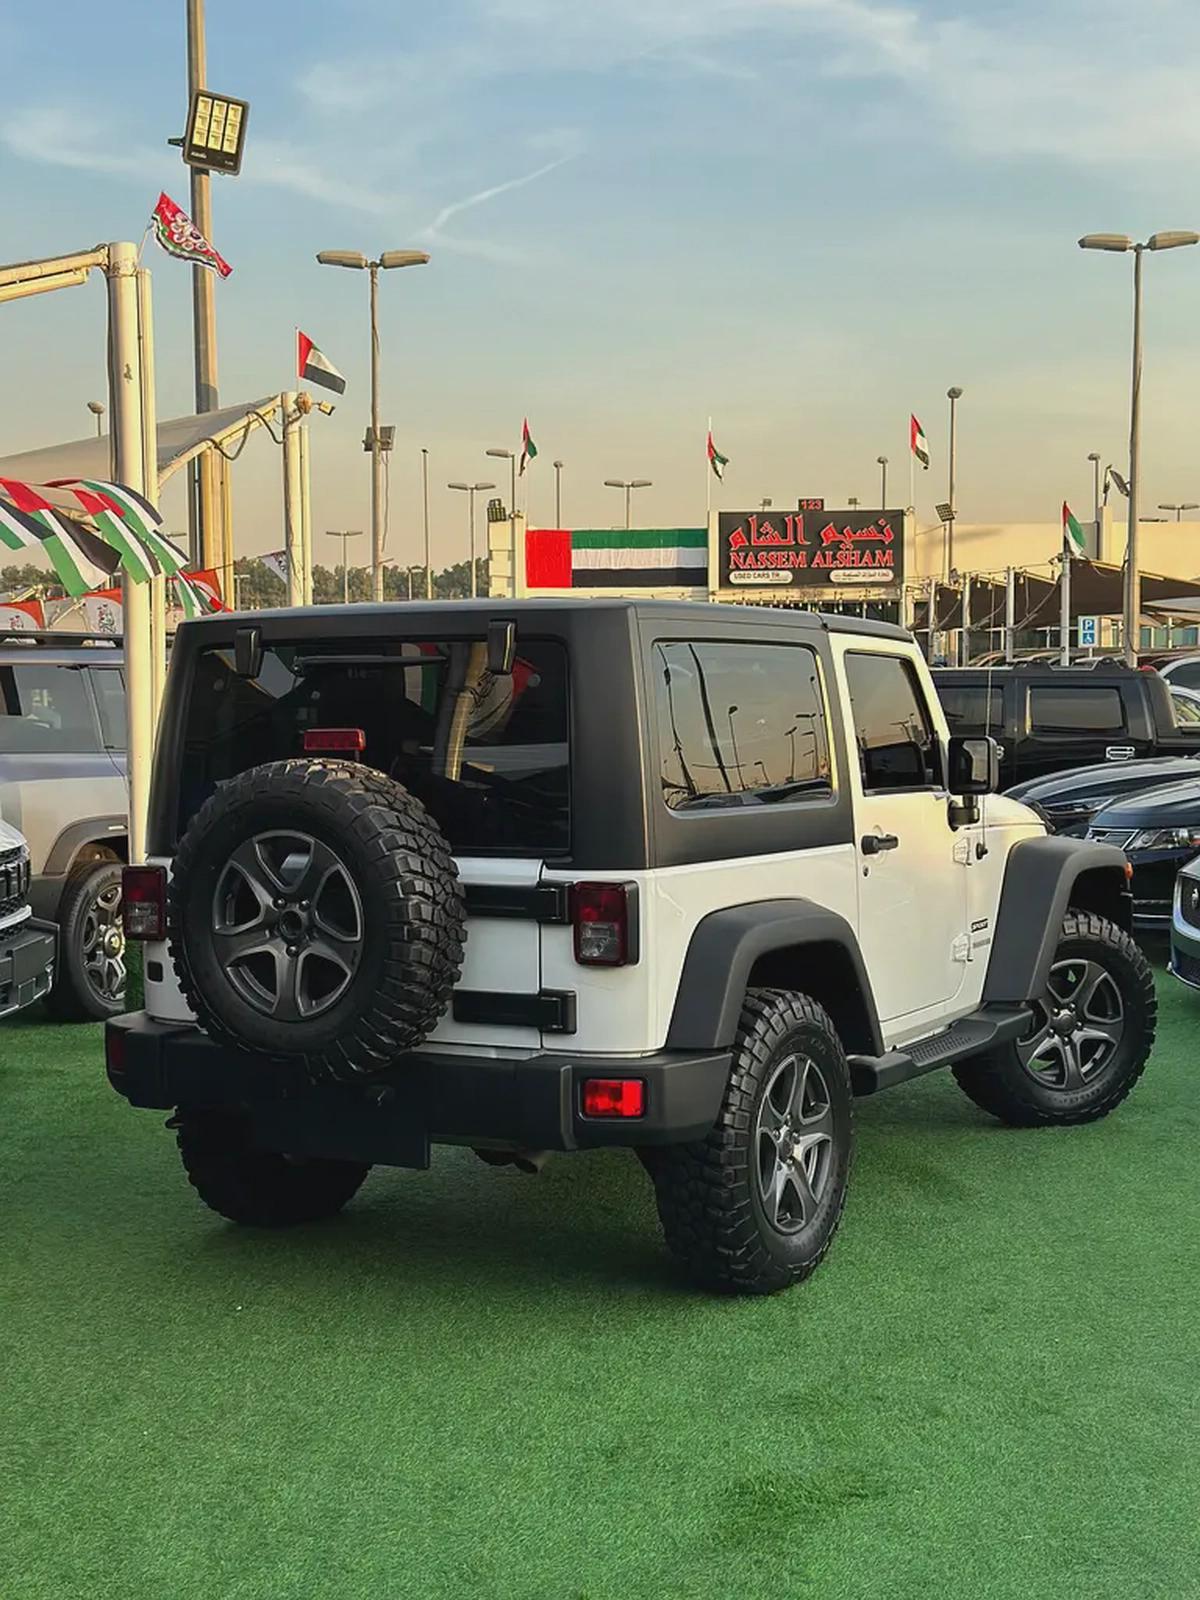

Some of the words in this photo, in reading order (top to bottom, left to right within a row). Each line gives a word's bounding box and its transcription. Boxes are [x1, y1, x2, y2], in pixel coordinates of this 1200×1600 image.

[801, 499, 822, 510] 123
[729, 514, 811, 551] الشام
[820, 517, 895, 552] نسيم
[729, 551, 807, 569] NASSEM
[811, 549, 894, 568] ALSHAM
[1085, 619, 1093, 630] P
